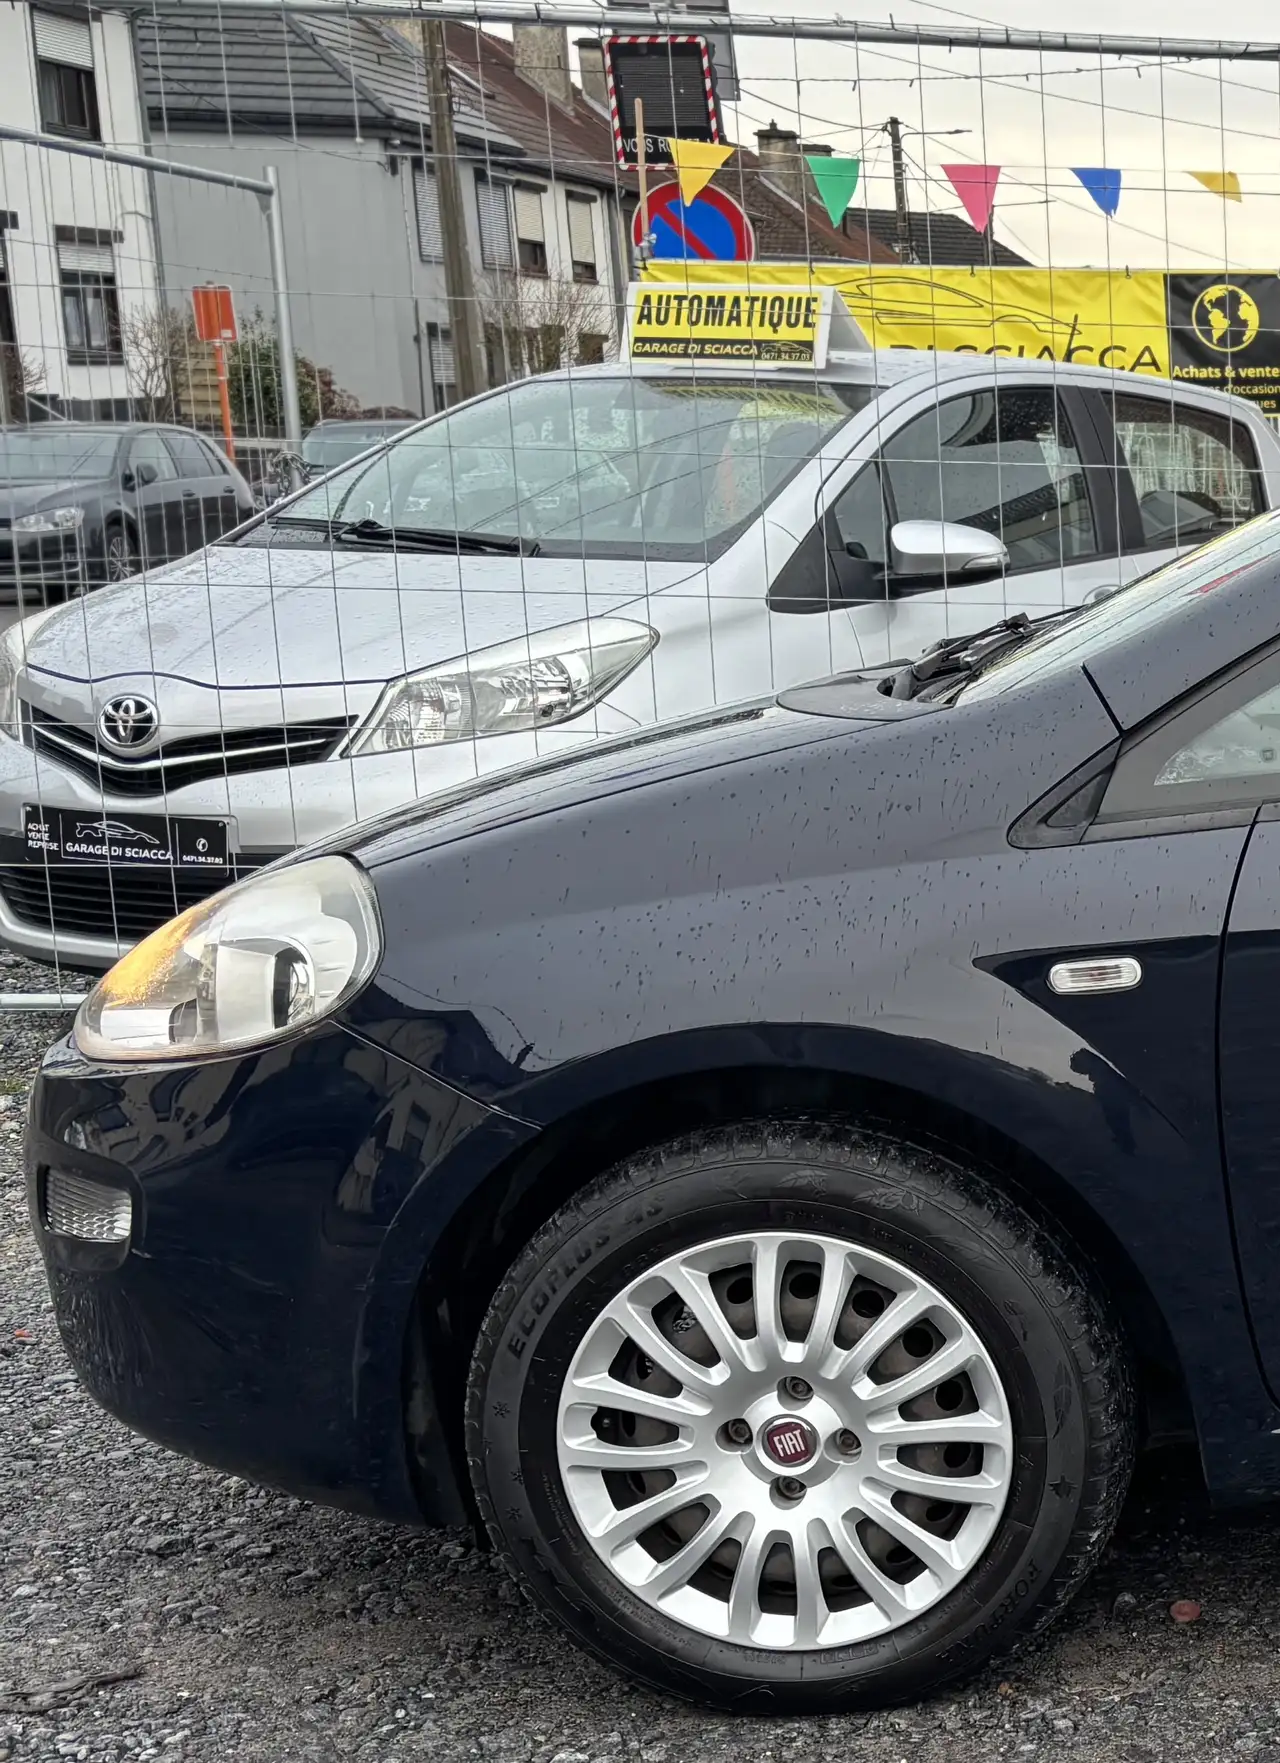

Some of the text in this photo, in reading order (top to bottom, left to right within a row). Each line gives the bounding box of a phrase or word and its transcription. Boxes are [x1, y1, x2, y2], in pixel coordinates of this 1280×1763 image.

[623, 138, 654, 153] VOS
[636, 294, 819, 335] AUTOMATIQUE
[633, 342, 758, 356] GARAGE DI SCIACCA
[1172, 364, 1222, 378] Achats
[1224, 365, 1236, 378] &
[65, 842, 174, 861] GARAGE DI SCIACCA
[773, 1429, 806, 1457] FIAT
